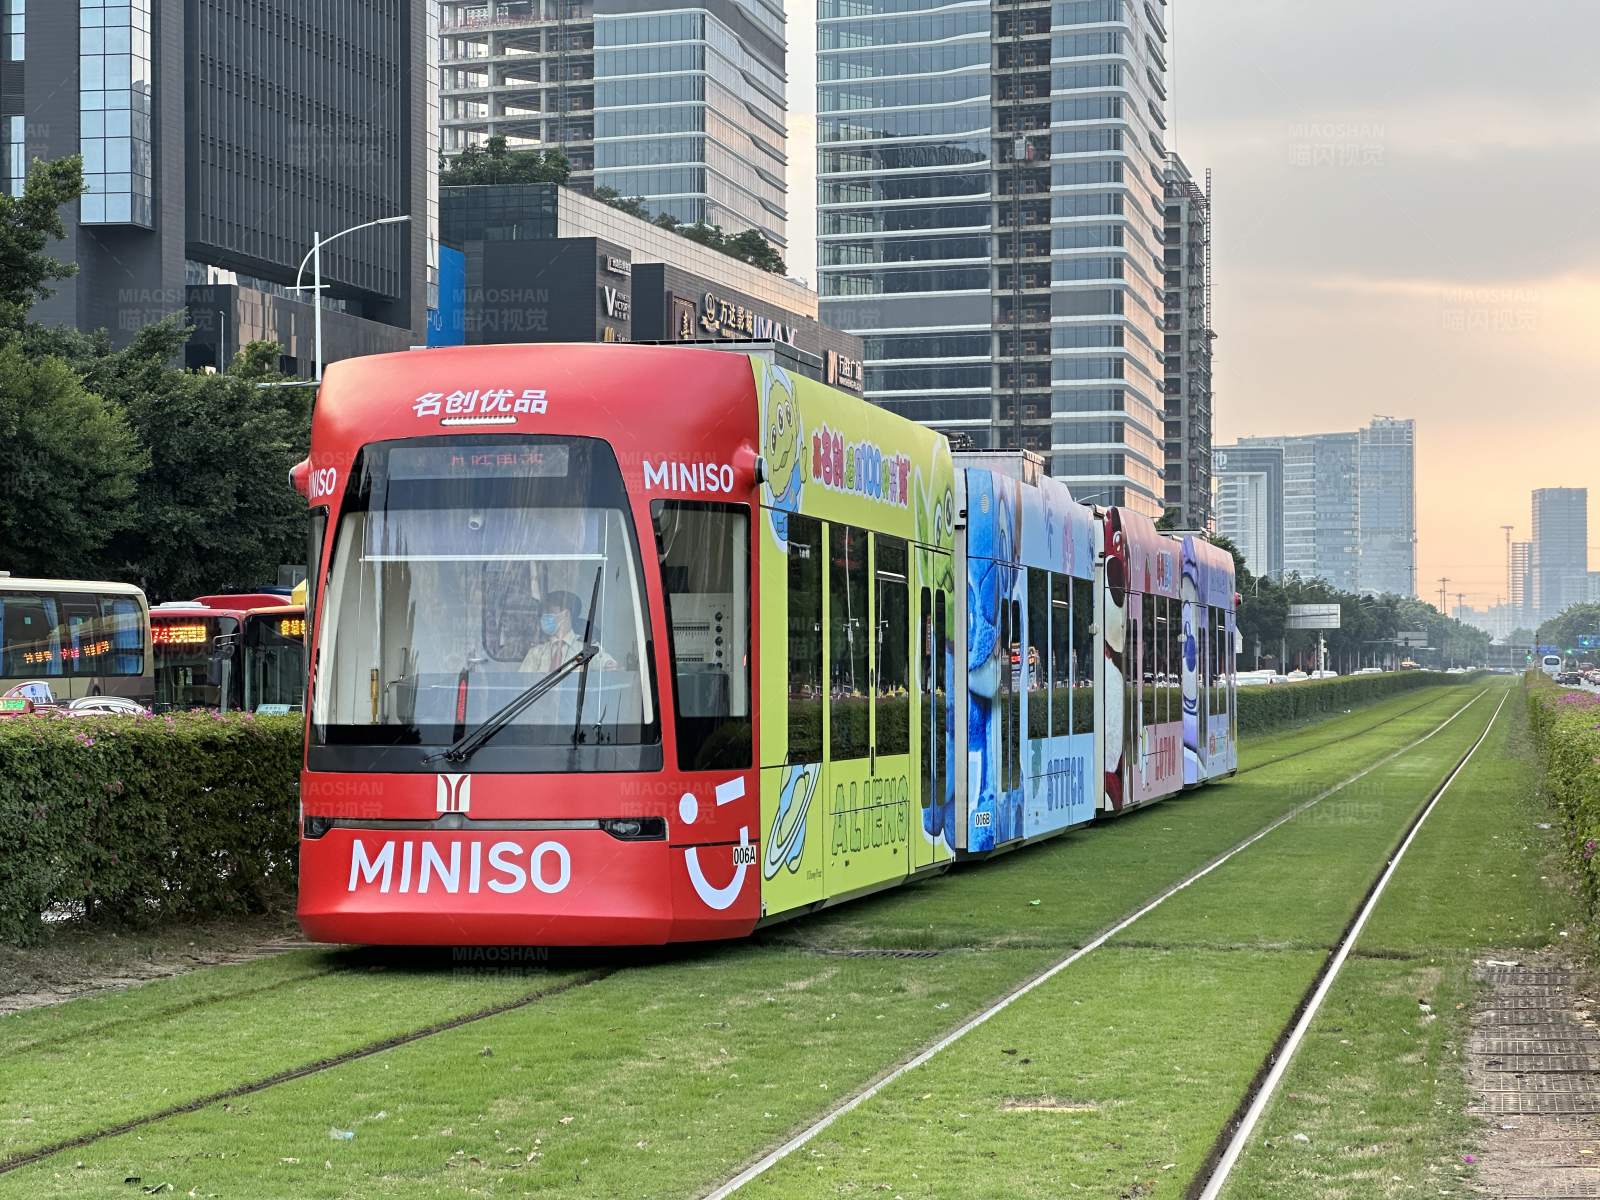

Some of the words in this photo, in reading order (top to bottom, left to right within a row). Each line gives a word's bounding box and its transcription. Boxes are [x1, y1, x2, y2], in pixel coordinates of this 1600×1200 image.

[754, 314, 798, 347] IMAX
[412, 388, 549, 417] 名创优品
[643, 460, 735, 493] MINISO
[1047, 756, 1085, 811] STITCH
[831, 774, 909, 856] ALIENS
[348, 839, 572, 895] MINISO
[733, 845, 757, 865] 006A
